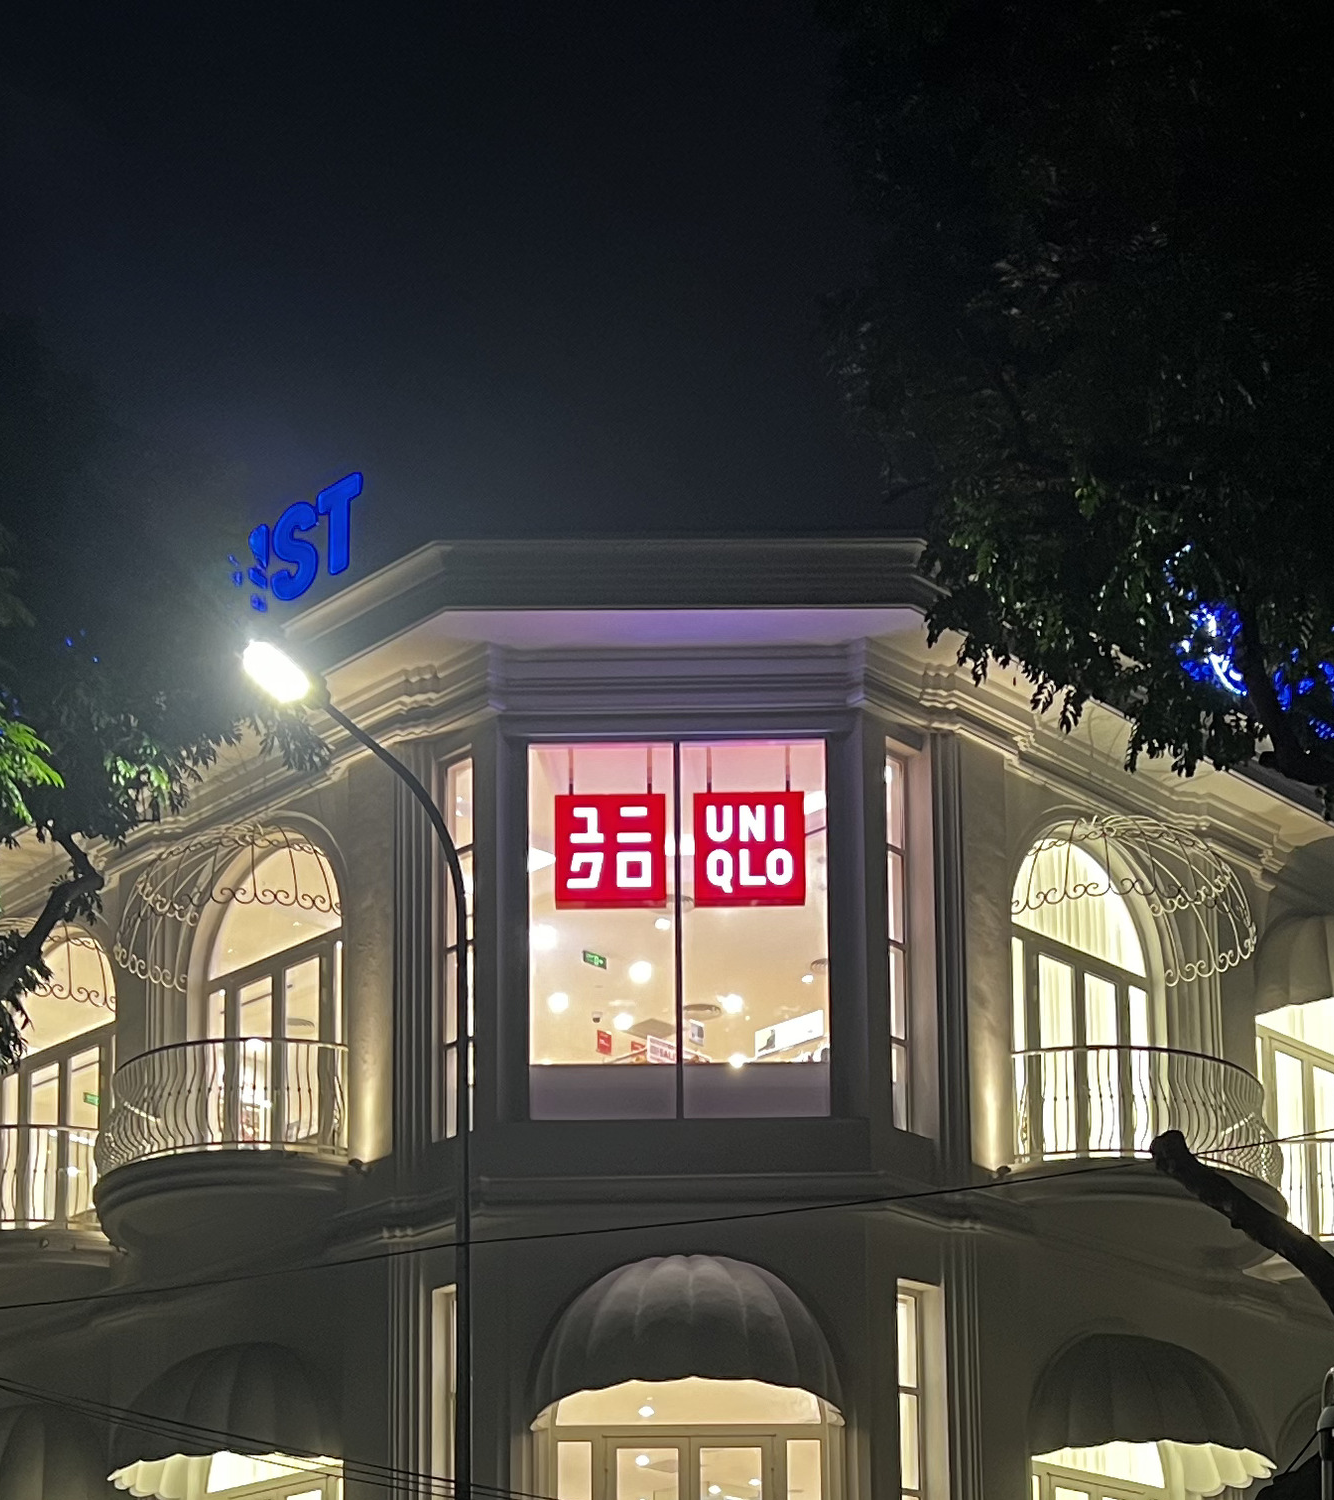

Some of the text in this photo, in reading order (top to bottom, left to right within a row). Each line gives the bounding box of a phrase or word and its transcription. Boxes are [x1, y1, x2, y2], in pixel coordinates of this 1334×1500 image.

[569, 806, 652, 844] ユニ
[705, 804, 785, 842] UNI
[566, 851, 652, 889] クロ
[706, 848, 794, 894] QLO
